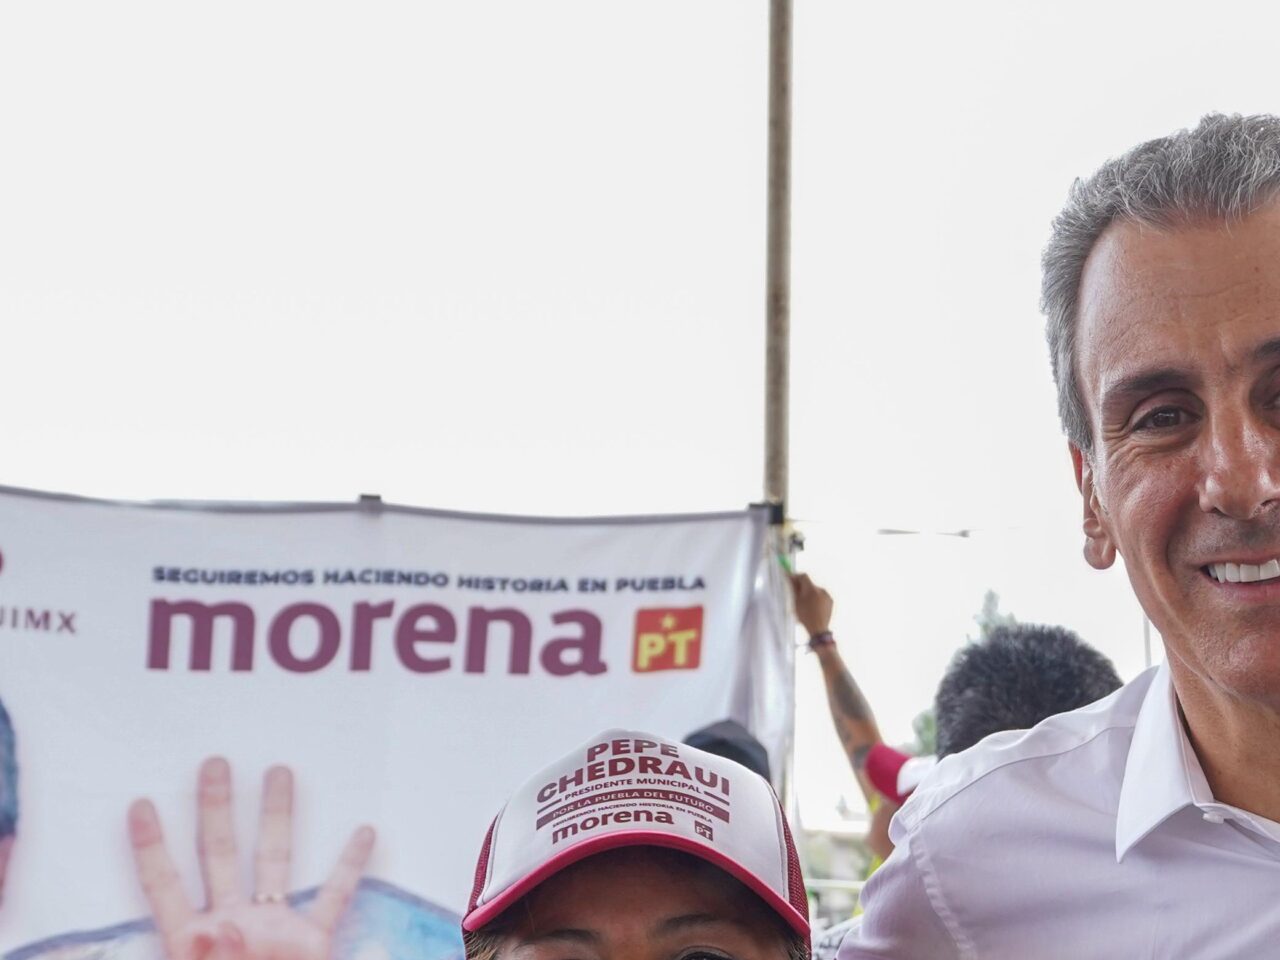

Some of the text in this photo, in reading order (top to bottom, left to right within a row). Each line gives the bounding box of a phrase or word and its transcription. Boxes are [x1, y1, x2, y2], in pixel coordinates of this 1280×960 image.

[153, 566, 706, 593] SEGUIREMOS HACIENDO HISTORIA EN PUEBLA
[146, 598, 608, 677] morena
[637, 630, 696, 669] PT
[587, 739, 679, 763] PEPE
[537, 756, 729, 803] CHEDRAUI
[565, 778, 701, 800] PRESIDENTE MUNICIPAL
[553, 791, 713, 818] POR LA PUEBLA DEL FUTURO
[553, 810, 674, 844] morena
